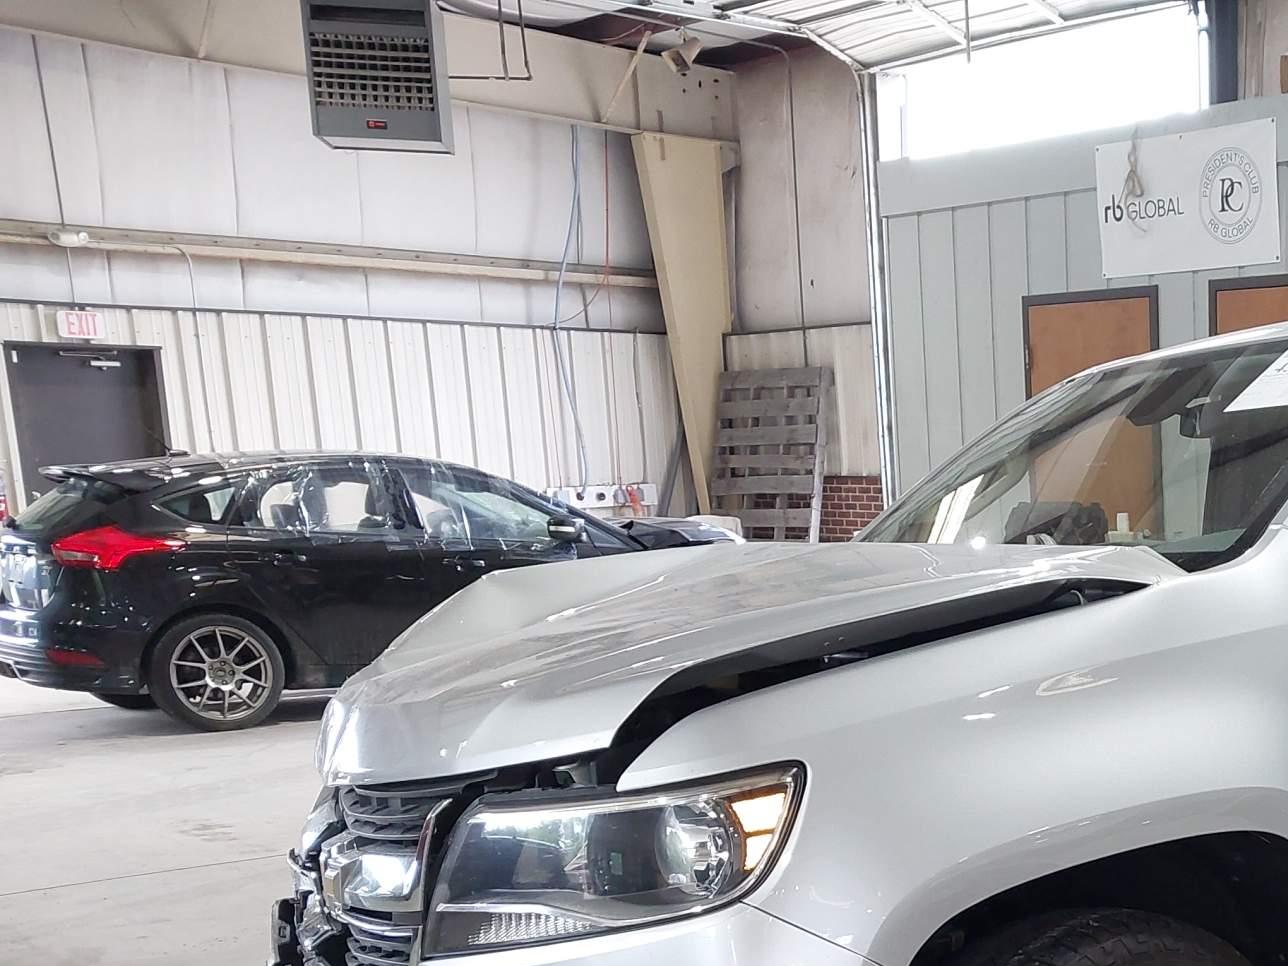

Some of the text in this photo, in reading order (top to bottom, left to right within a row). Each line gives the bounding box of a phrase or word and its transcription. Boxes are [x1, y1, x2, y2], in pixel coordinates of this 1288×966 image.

[1202, 152, 1260, 198] PRESIDENT'S CLUB
[1104, 194, 1185, 223] rb GLOBAL
[1207, 217, 1254, 238] RB GLOBAL
[64, 311, 98, 337] EXIT
